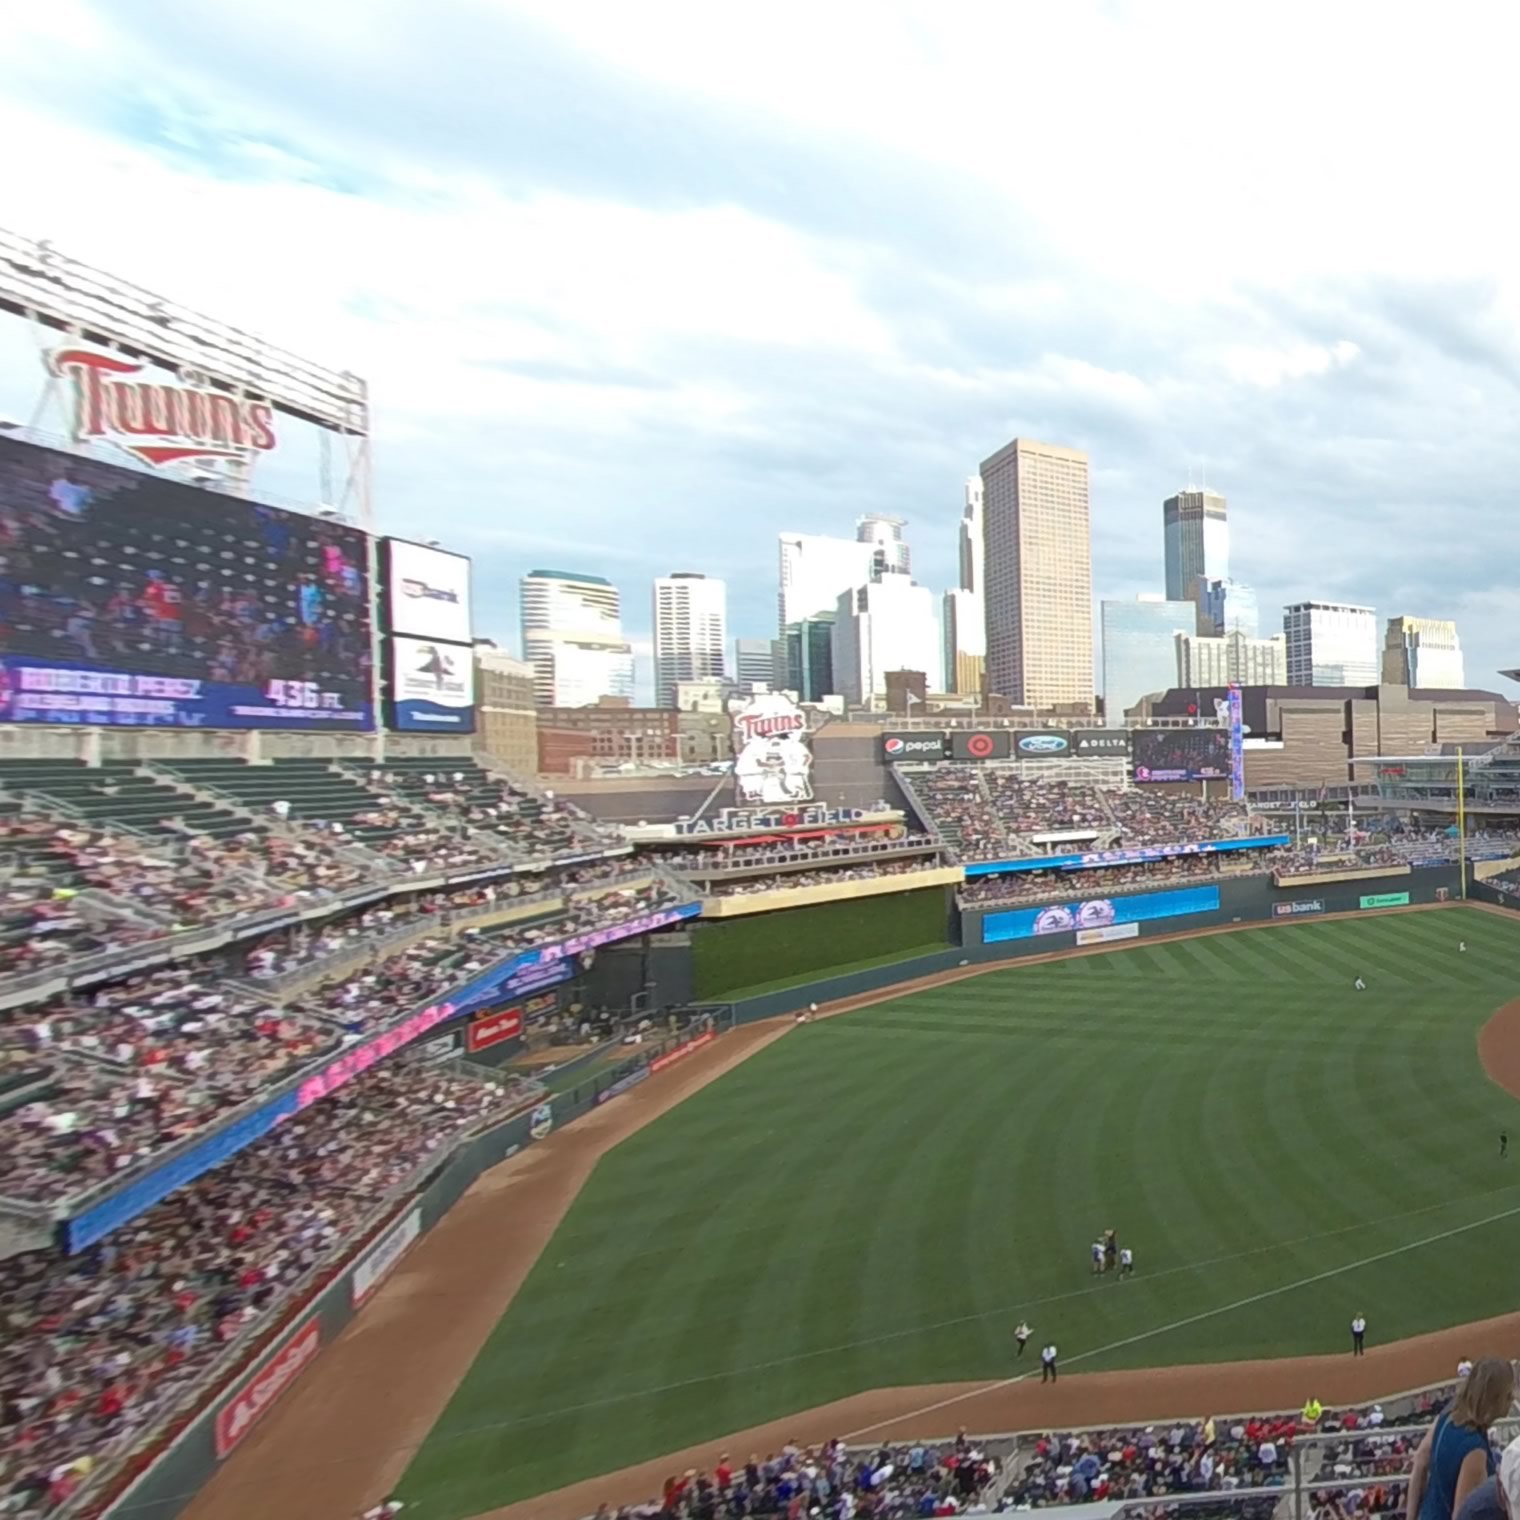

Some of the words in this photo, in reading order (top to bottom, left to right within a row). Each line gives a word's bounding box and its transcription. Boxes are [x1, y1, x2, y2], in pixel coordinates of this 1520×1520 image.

[56, 349, 276, 452] Twins
[264, 678, 319, 709] 436
[737, 714, 804, 740] Twins
[905, 739, 942, 752] pepsi
[1090, 739, 1127, 747] DELTA
[677, 813, 782, 835] TARGET
[803, 808, 864, 825] FIELD
